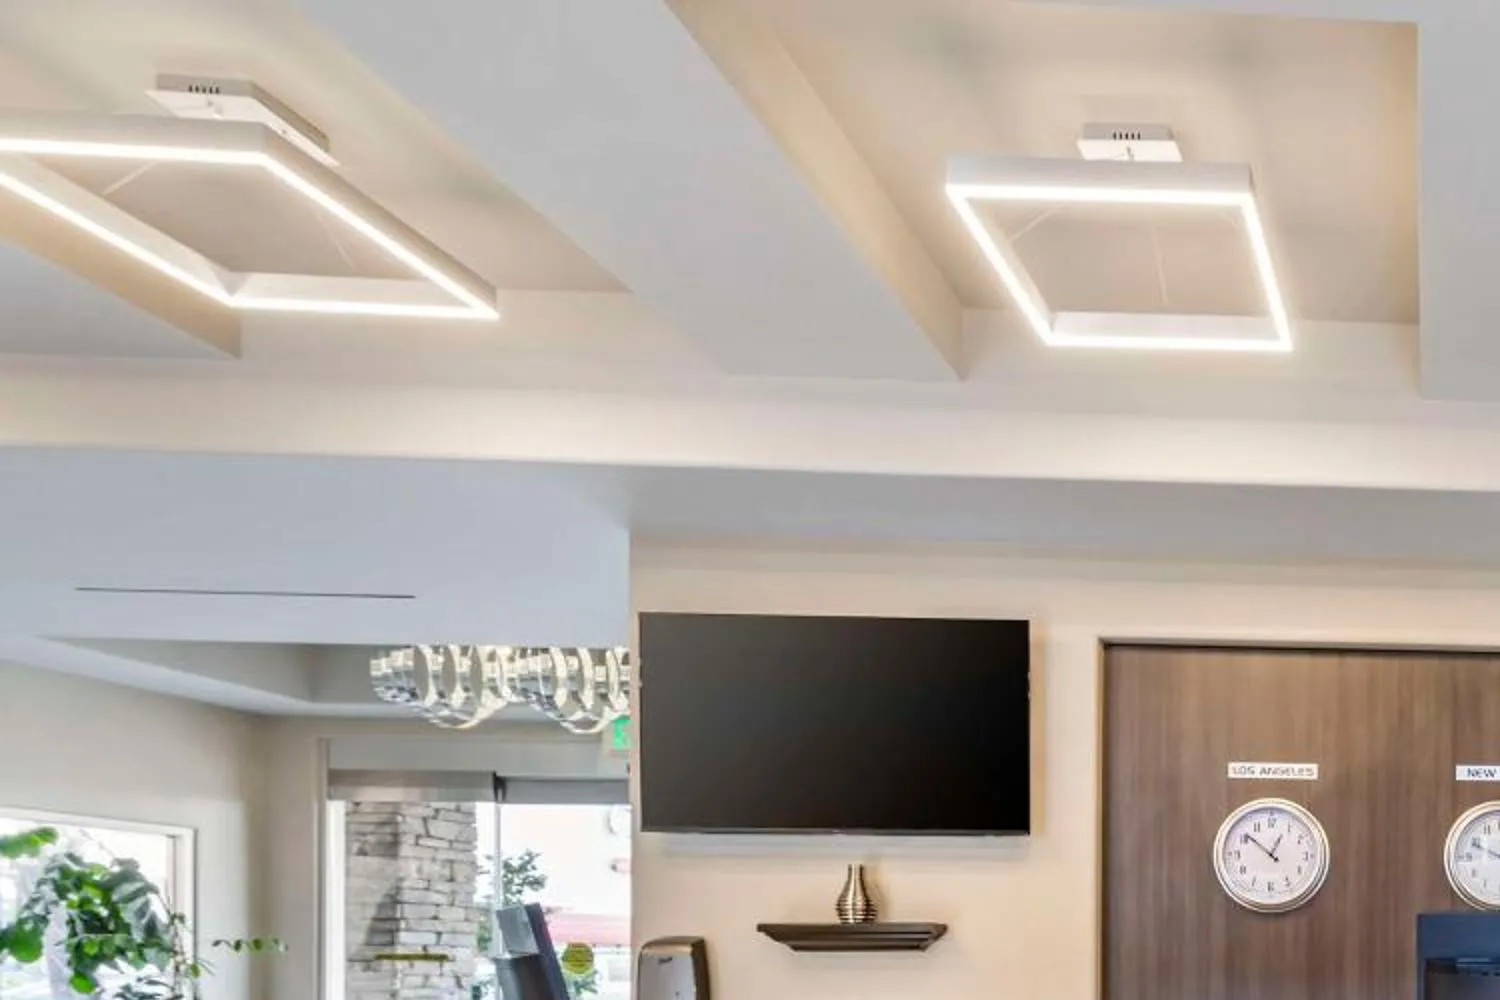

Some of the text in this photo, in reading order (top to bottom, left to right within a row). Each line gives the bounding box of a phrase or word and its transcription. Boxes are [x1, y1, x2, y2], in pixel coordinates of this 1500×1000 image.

[1232, 766, 1314, 777] LOS ANGELES
[1467, 767, 1497, 778] NEW
